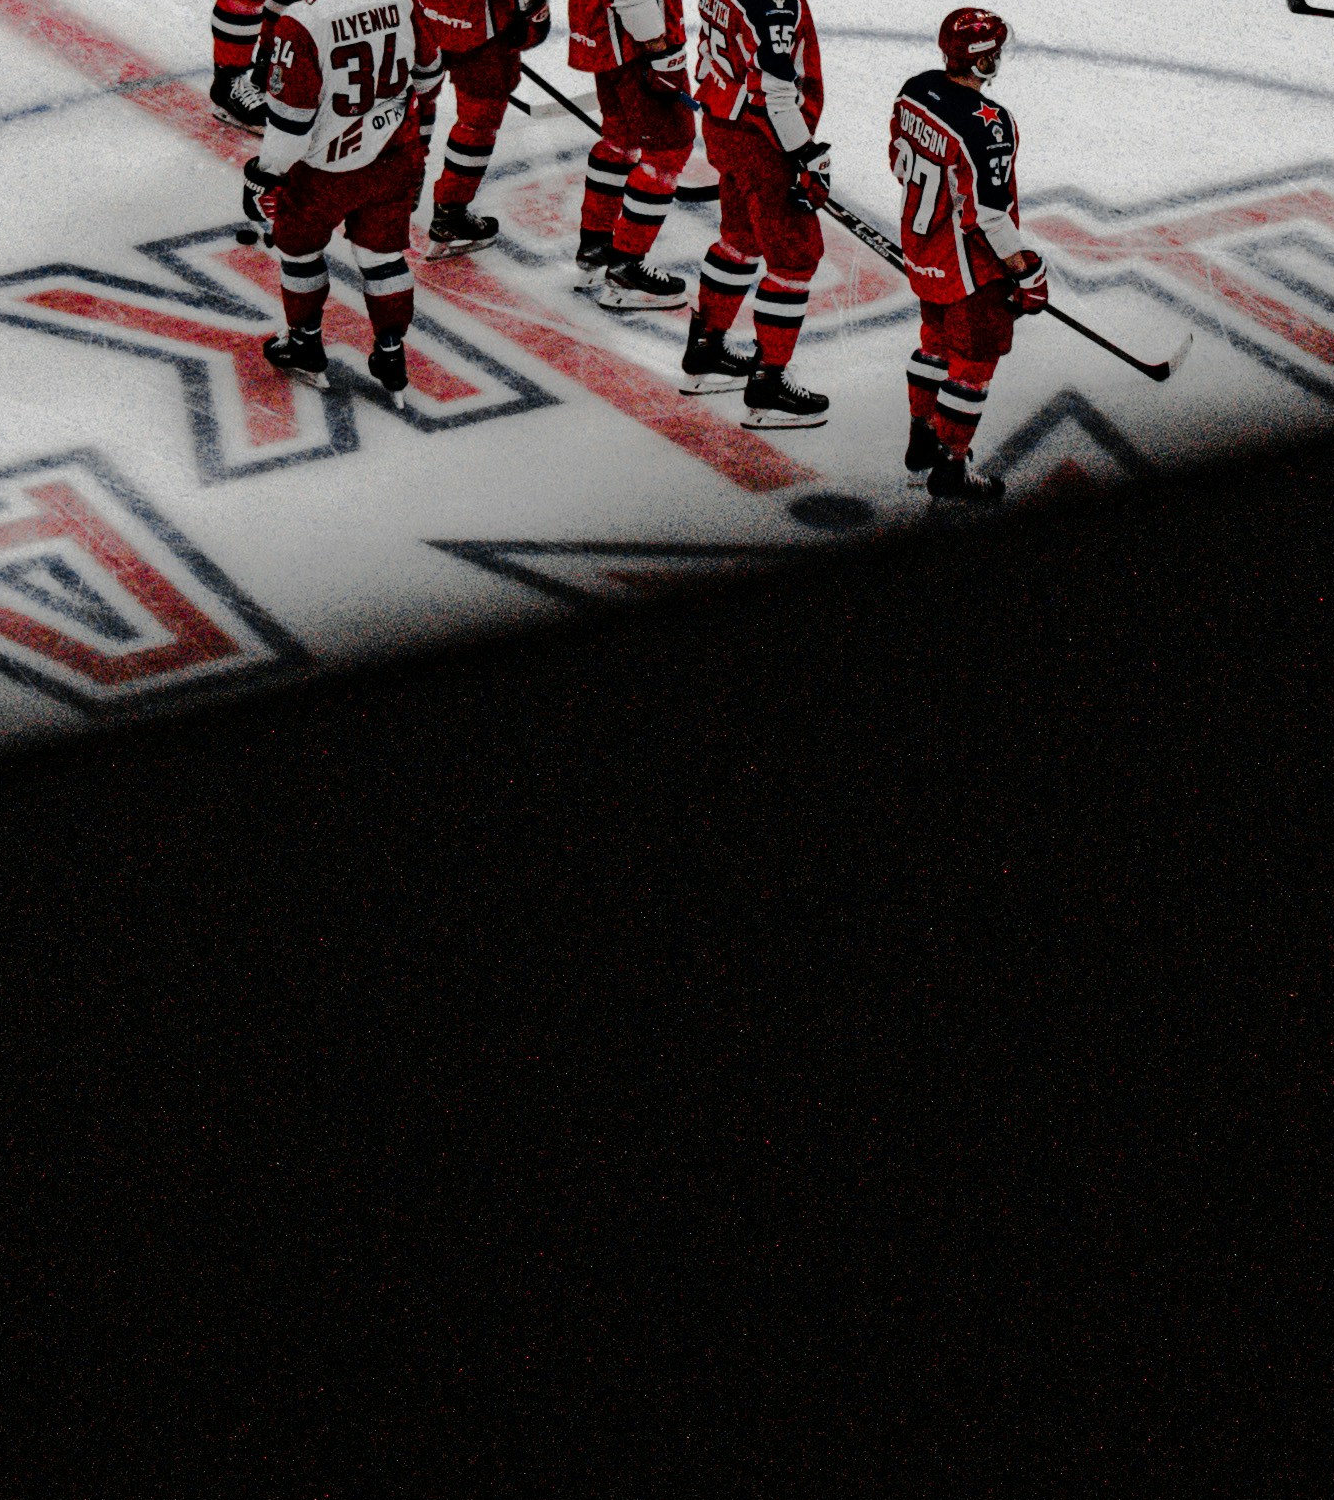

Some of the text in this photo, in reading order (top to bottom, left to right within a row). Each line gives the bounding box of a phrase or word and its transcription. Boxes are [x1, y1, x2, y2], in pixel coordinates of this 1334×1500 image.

[330, 4, 401, 44] ILYENKO
[769, 24, 796, 55] 55
[330, 32, 410, 117] 34
[989, 154, 1012, 187] 37
